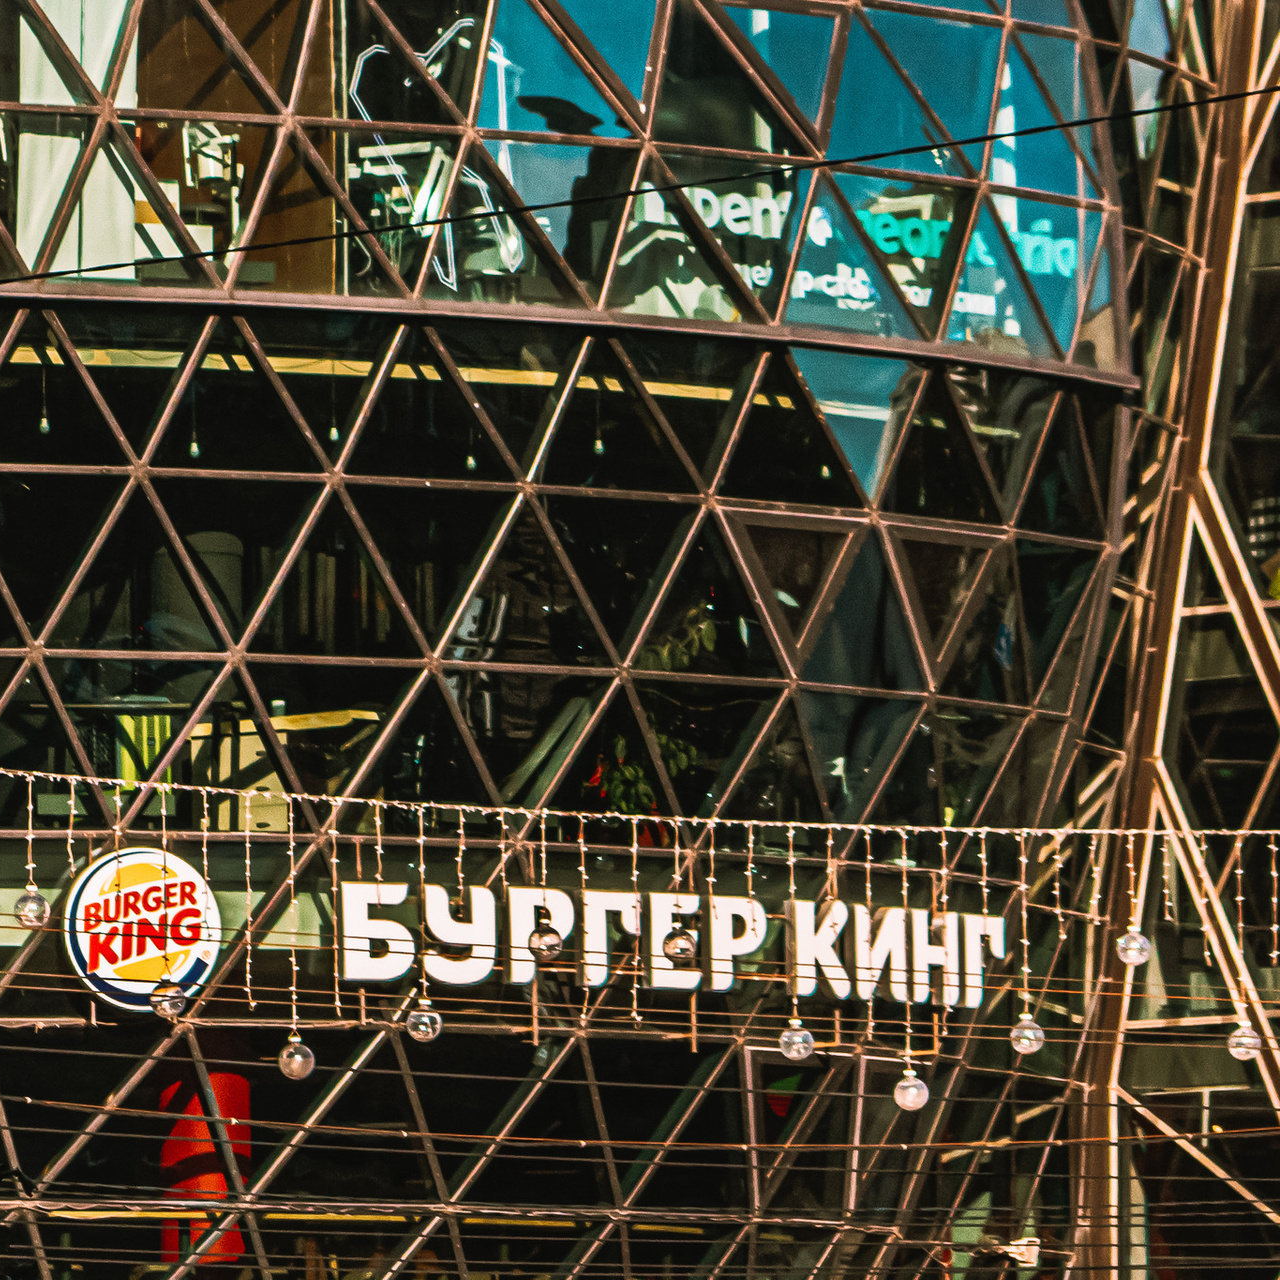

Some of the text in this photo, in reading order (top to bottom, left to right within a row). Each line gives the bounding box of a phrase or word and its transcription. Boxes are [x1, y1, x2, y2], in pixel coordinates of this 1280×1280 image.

[83, 880, 198, 932] BURGER
[86, 907, 202, 975] KING
[341, 880, 1006, 1009] БУРГЕР КИНГ
